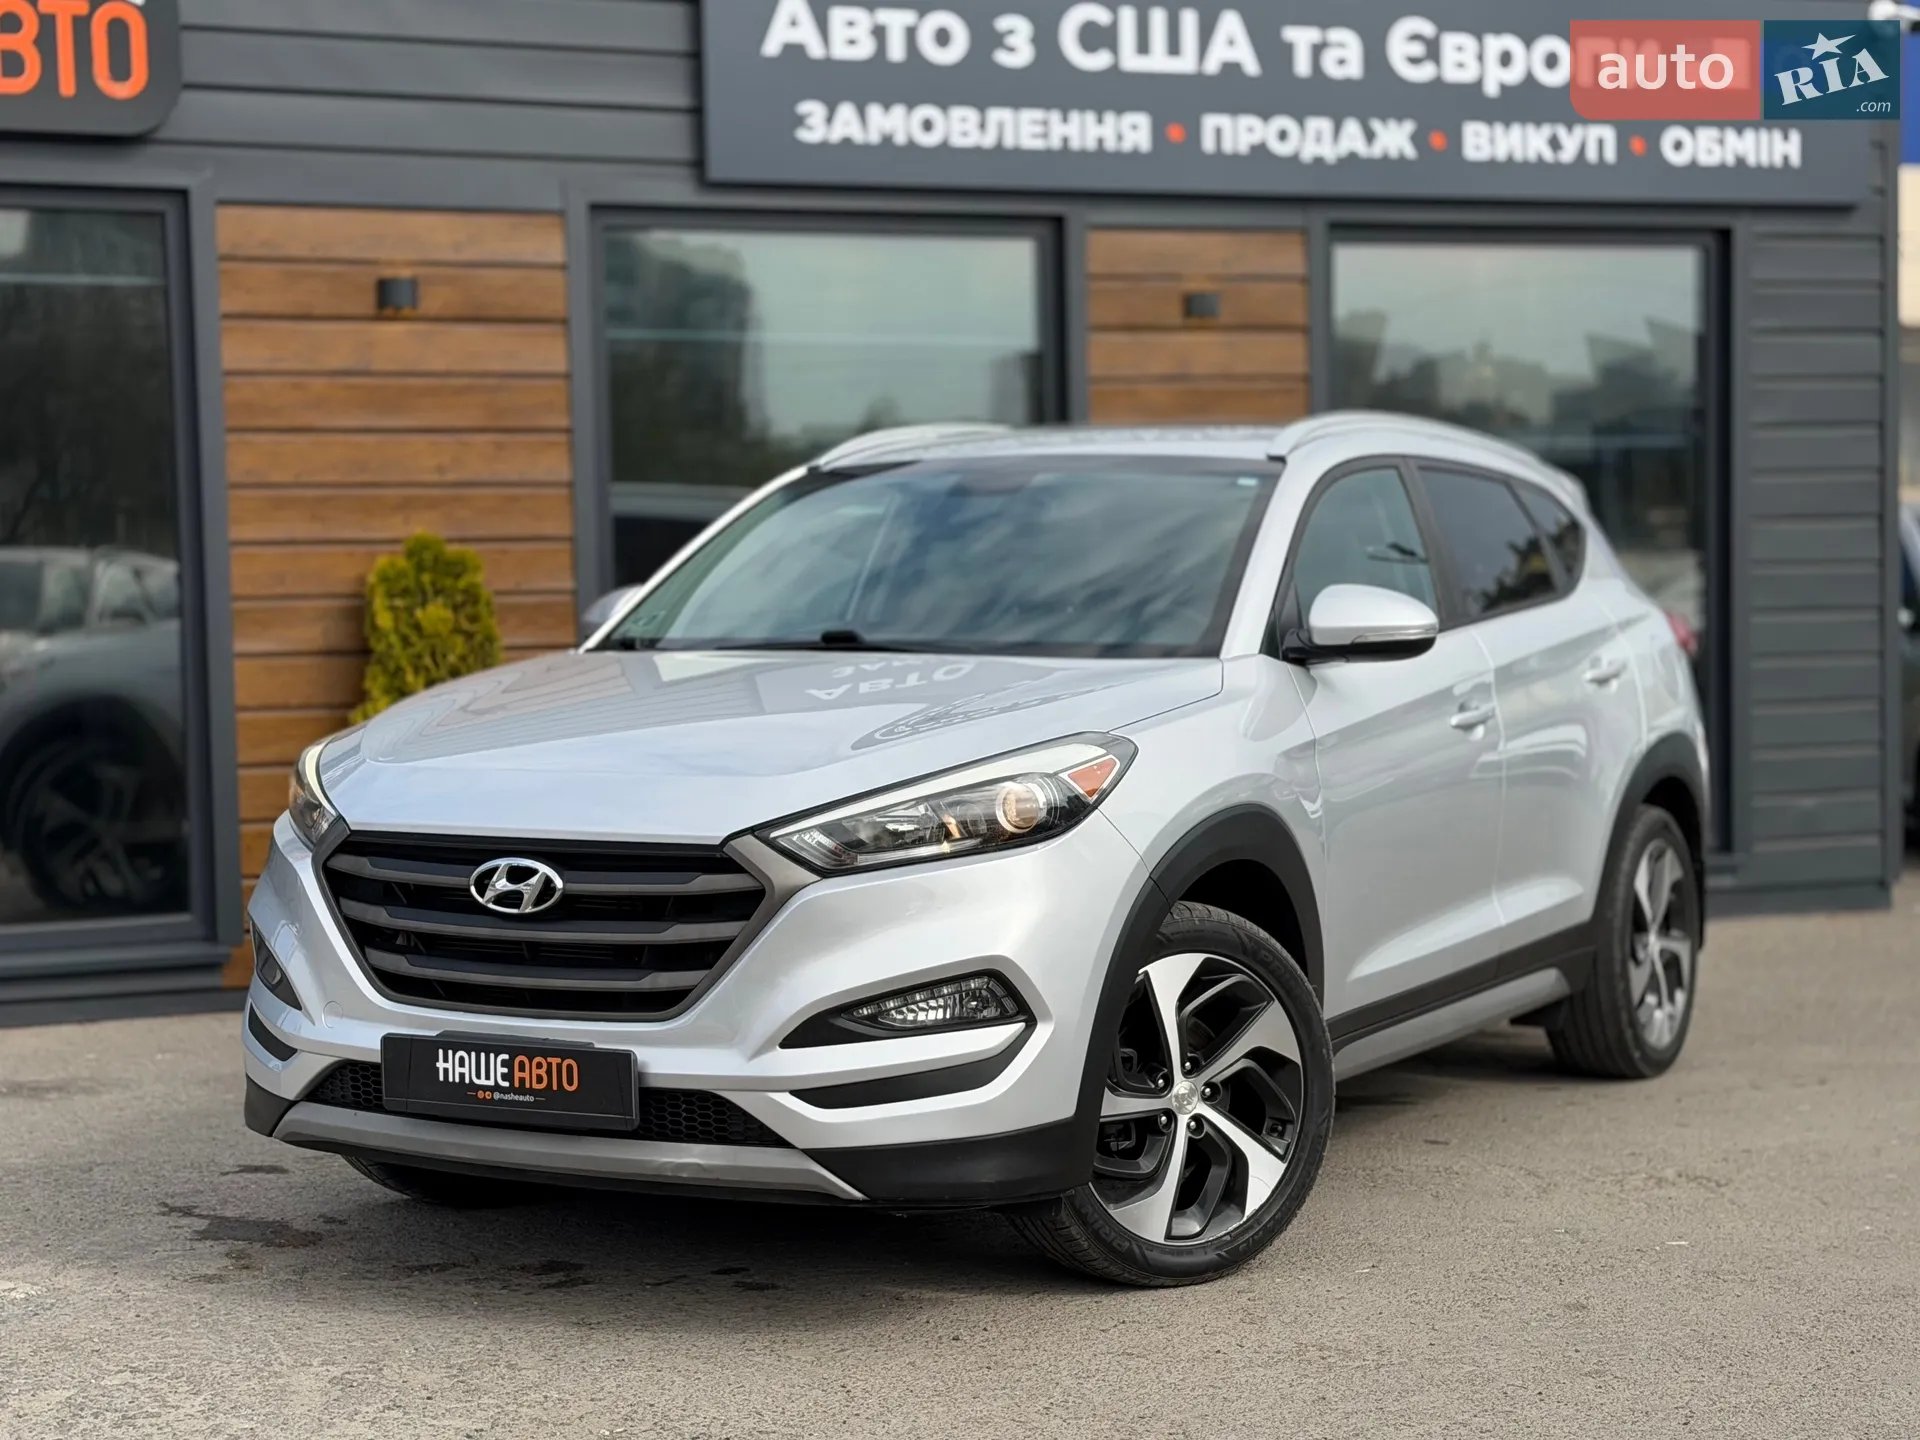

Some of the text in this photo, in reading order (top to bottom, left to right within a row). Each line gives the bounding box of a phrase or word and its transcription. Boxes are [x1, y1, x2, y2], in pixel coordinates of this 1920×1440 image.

[760, 0, 971, 66] Авто
[991, 13, 1036, 69] з
[1057, 2, 1263, 78] США
[1281, 25, 1365, 81] та
[795, 99, 1802, 169] ЗАМОВЛЕННЯ ПРОДАЖ ВИКУП ОБМІН
[436, 1048, 579, 1092] НАШЕ АВТО
